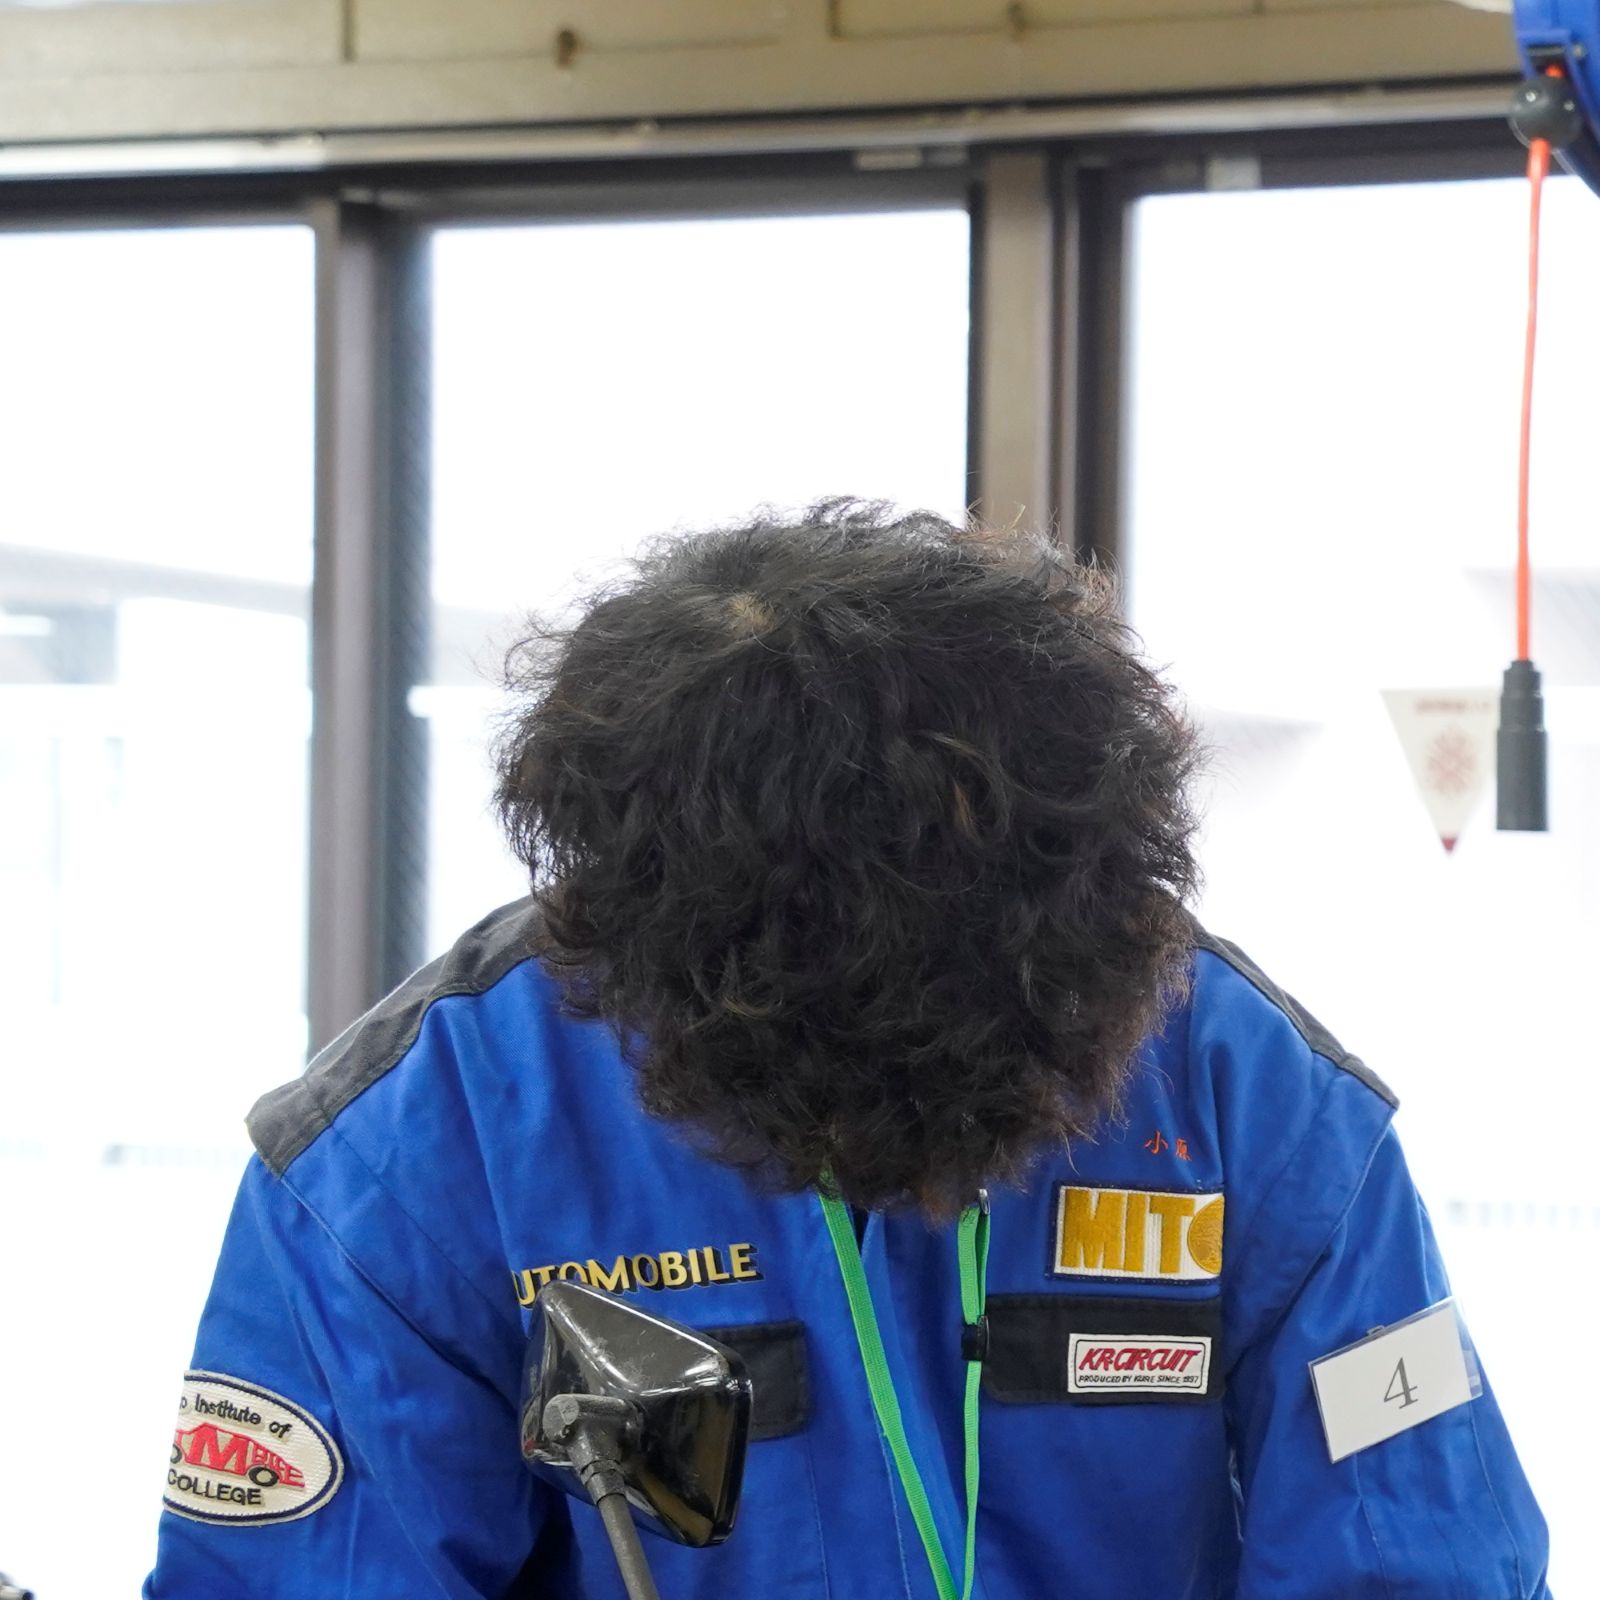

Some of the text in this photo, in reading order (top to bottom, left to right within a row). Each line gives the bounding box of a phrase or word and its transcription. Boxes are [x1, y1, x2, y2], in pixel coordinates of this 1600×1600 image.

[511, 1242, 764, 1310] UTOMOBILE
[1079, 1375, 1121, 1384] PRODUCED
[1383, 1357, 1419, 1410] 4
[269, 1421, 293, 1439] of
[167, 1468, 263, 1506] COLLEGE
